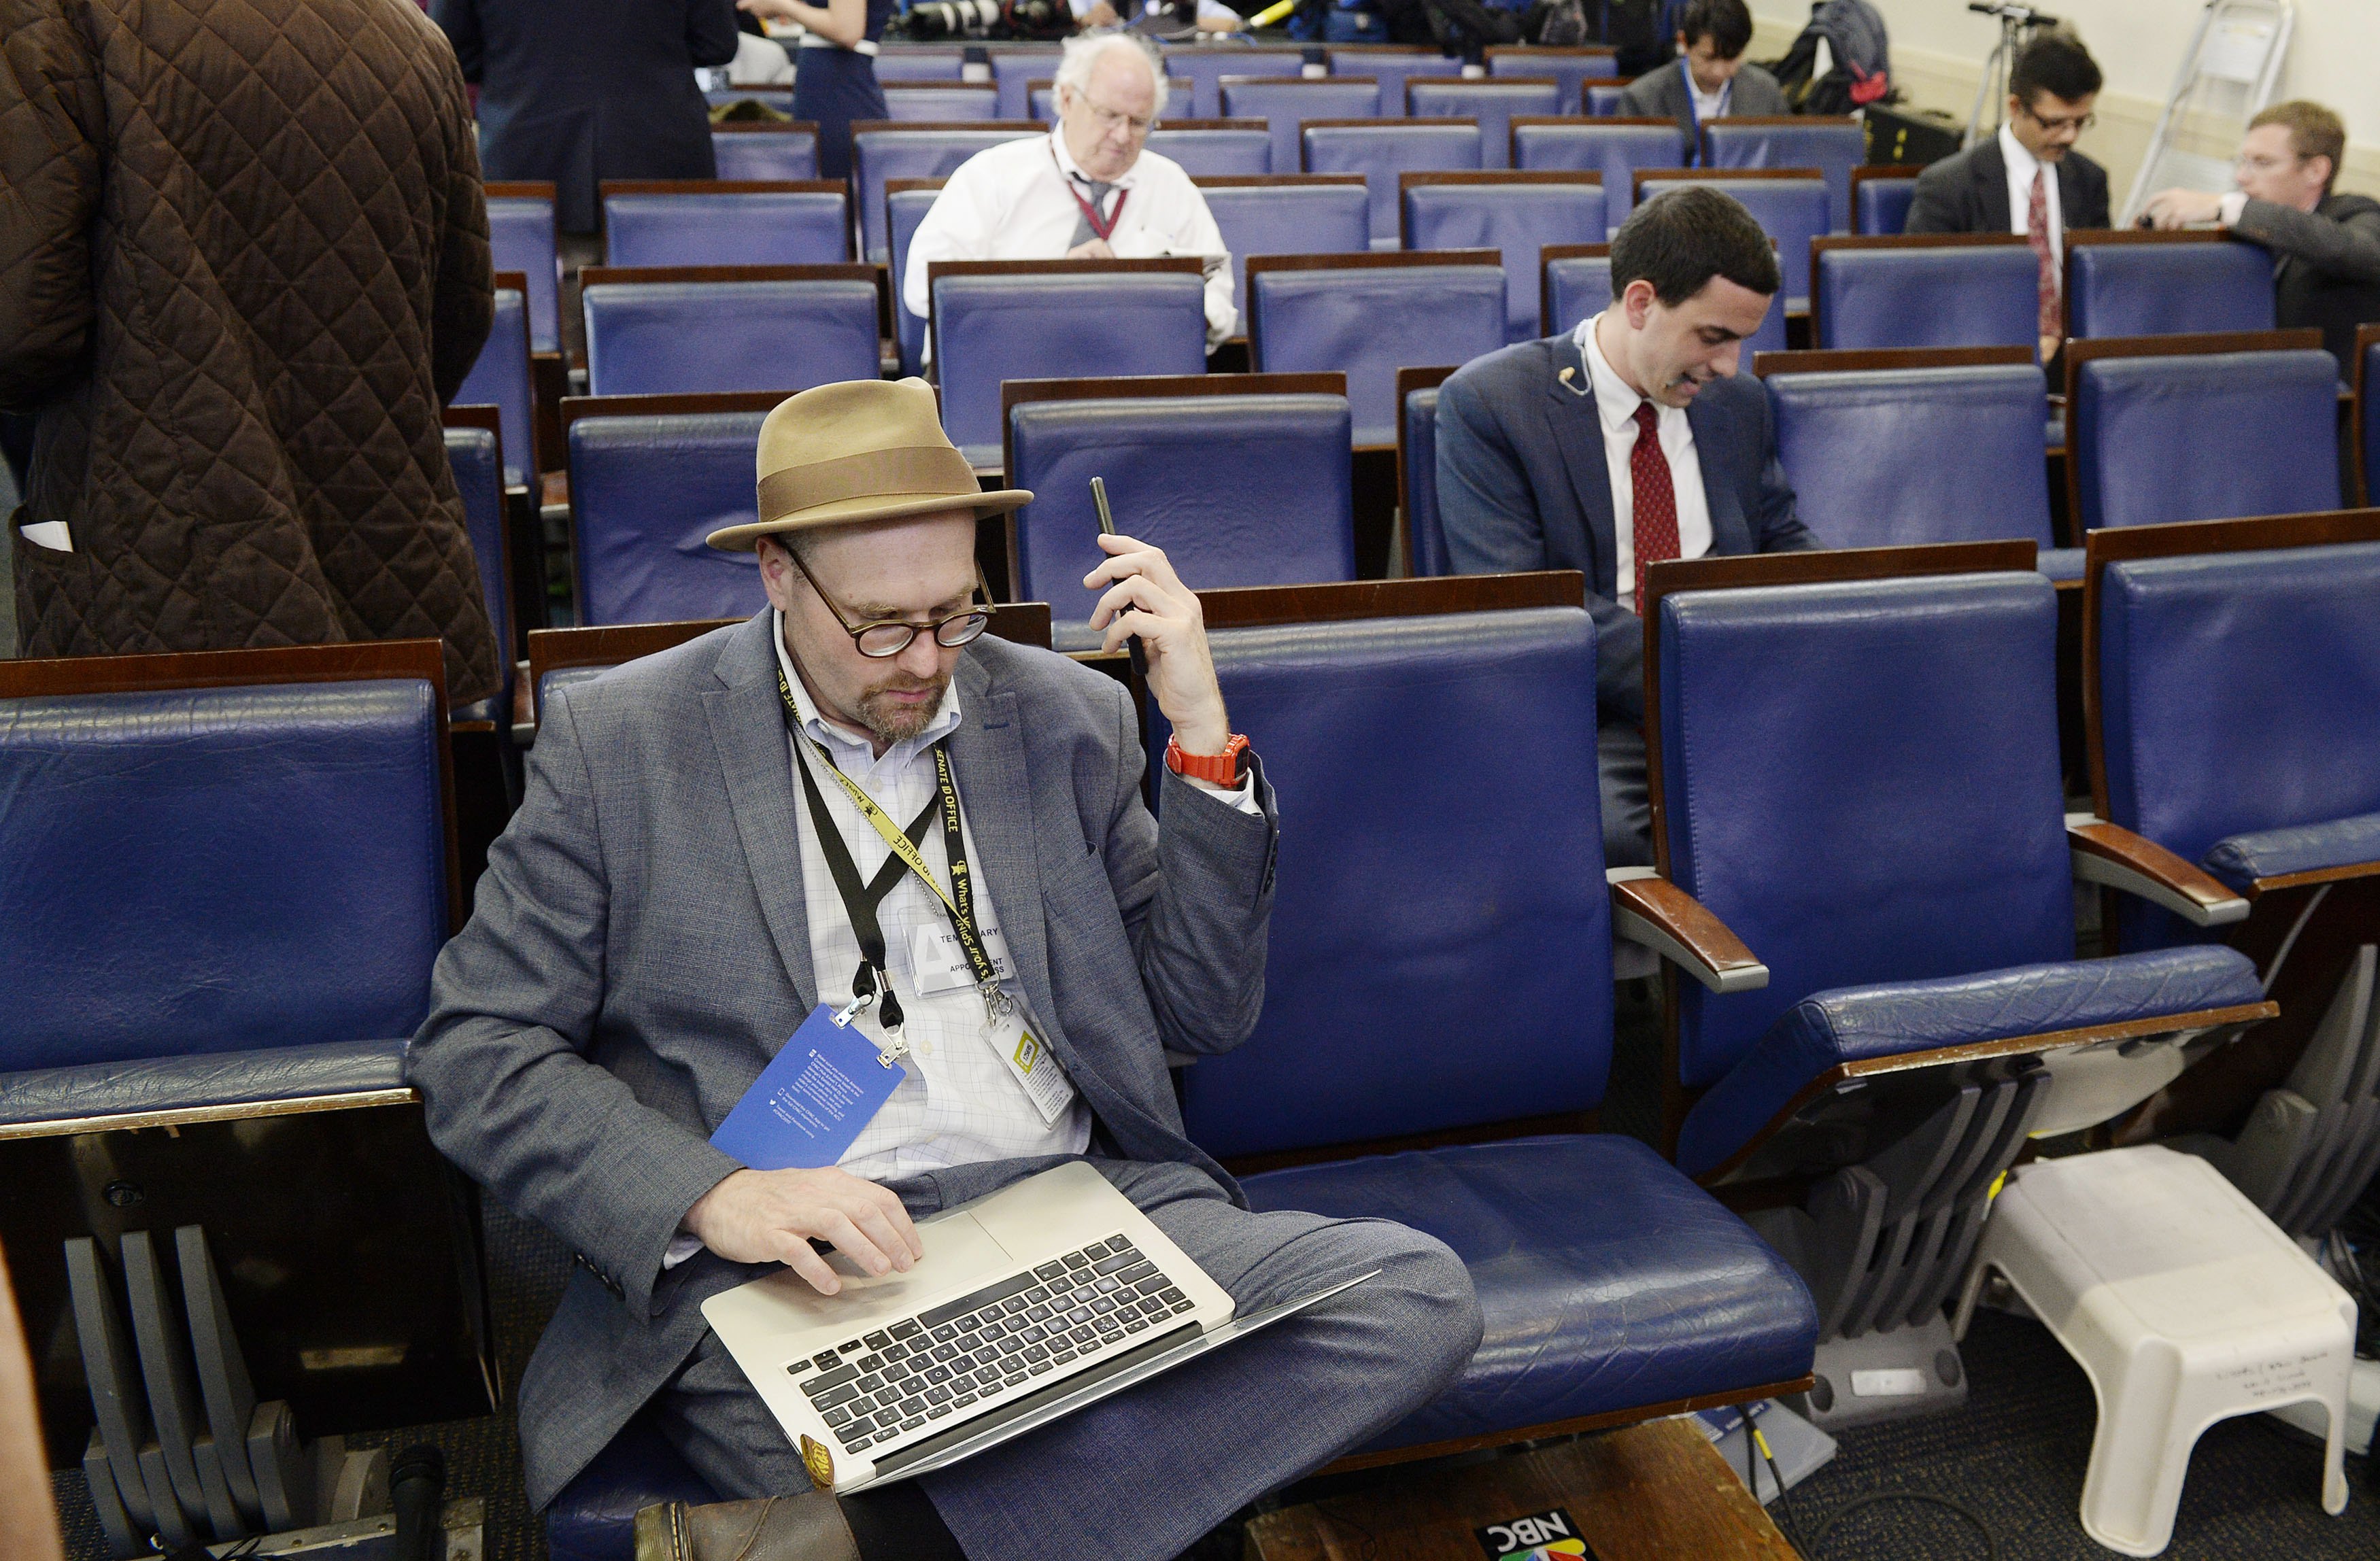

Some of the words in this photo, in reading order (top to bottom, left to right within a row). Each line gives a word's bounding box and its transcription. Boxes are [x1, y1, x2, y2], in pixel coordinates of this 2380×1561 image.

[935, 749, 949, 784] SENATE
[941, 785, 952, 795] ID
[945, 795, 958, 833] OFFICE
[957, 878, 969, 915] What's
[940, 928, 998, 944] TEMARY
[1487, 1511, 1570, 1553] NBC
